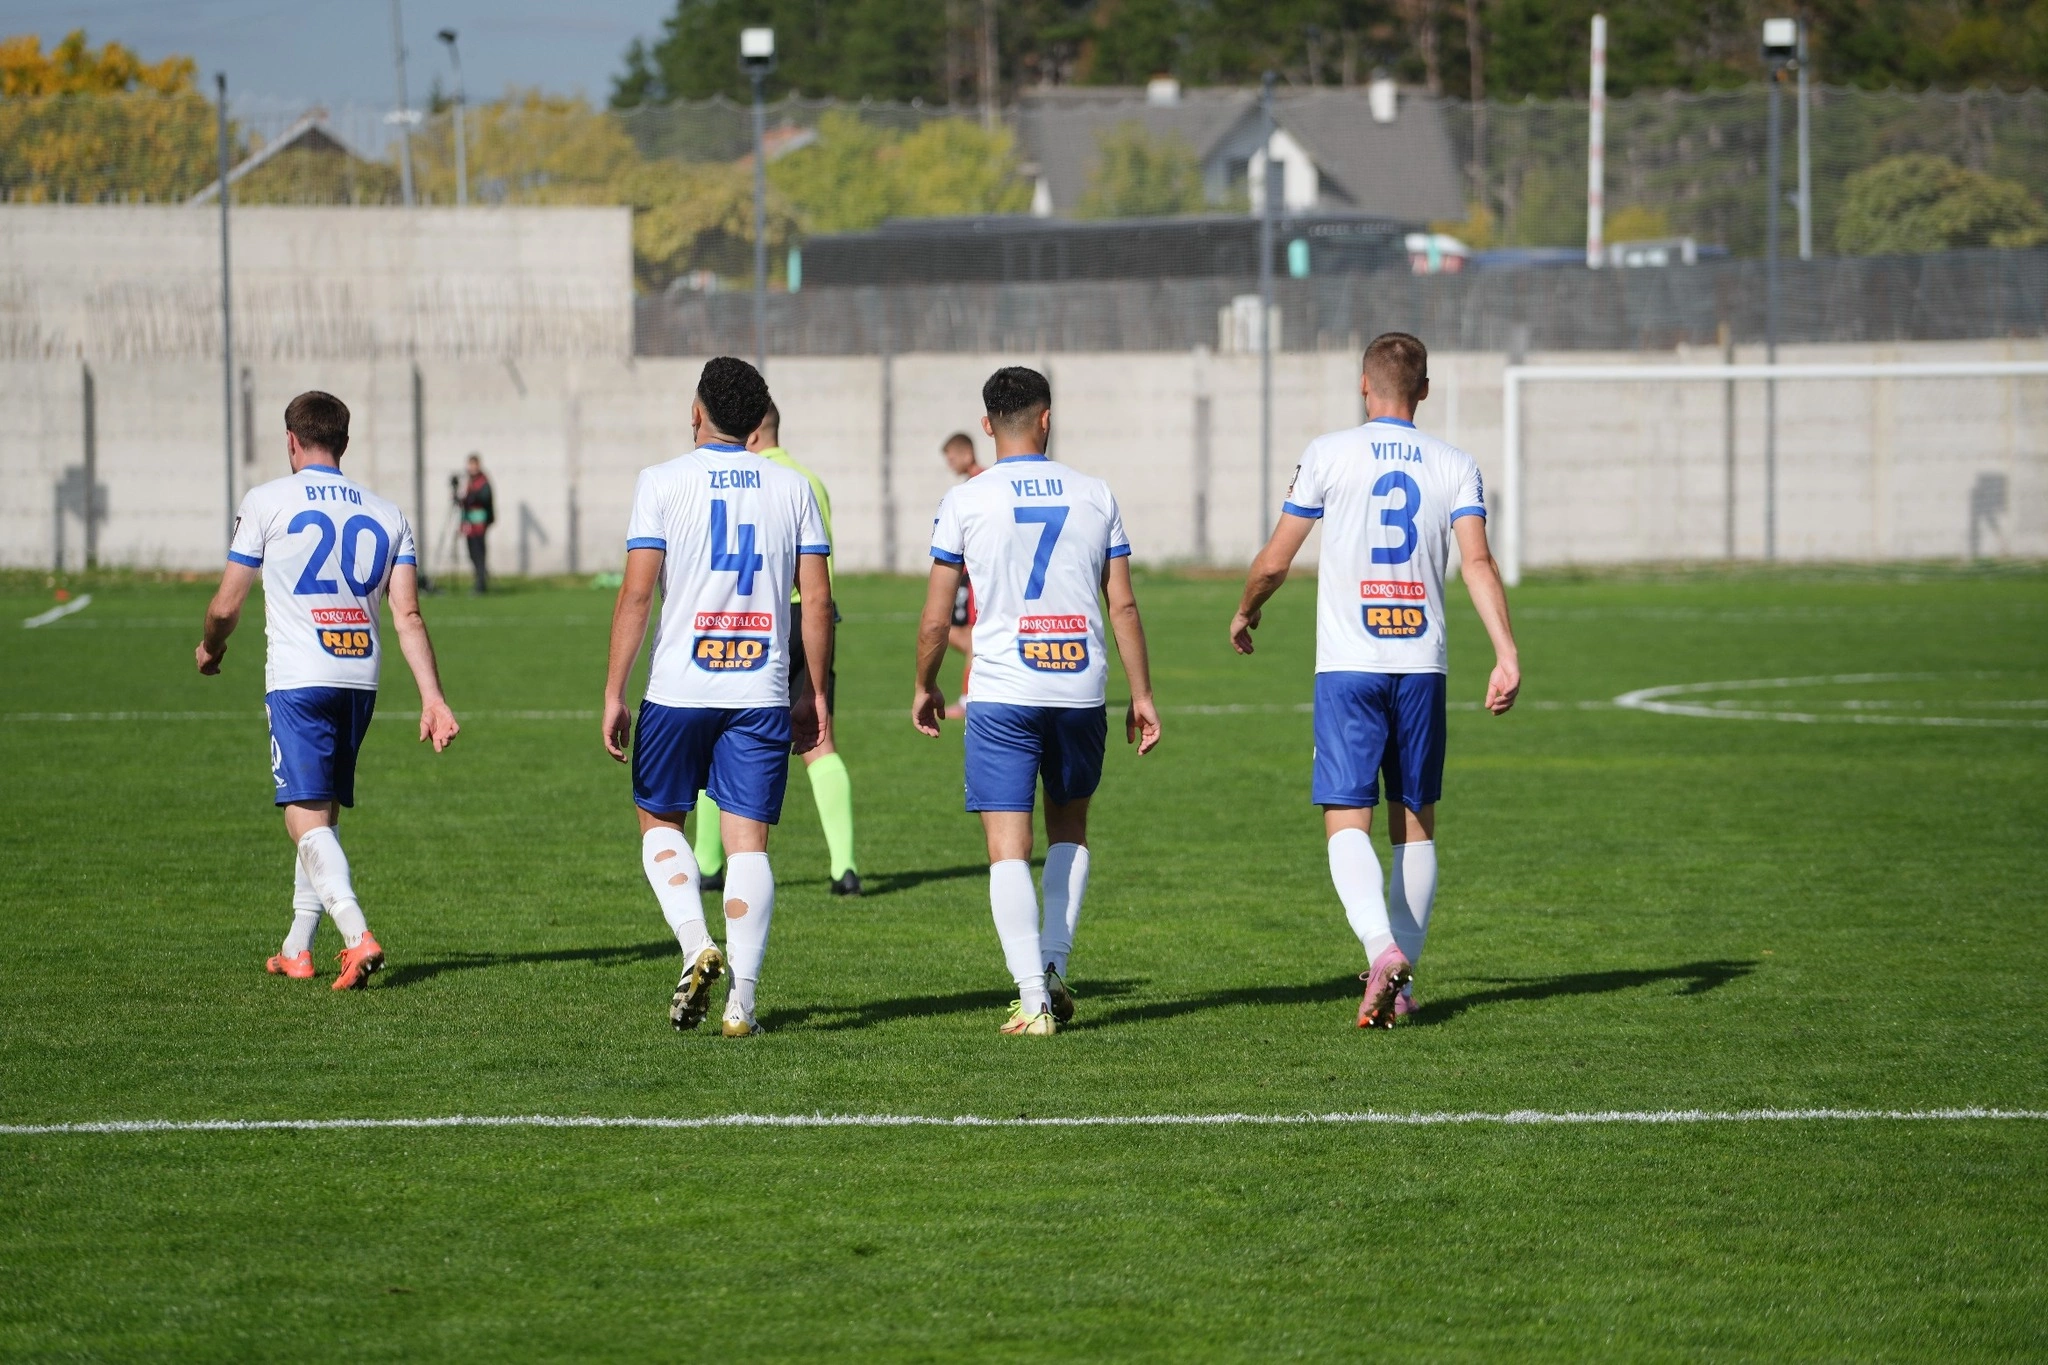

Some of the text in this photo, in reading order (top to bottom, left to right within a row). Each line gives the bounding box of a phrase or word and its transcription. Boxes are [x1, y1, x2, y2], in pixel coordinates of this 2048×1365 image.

[1370, 442, 1422, 463] VITIJA
[708, 469, 760, 489] ZEQIRI
[1010, 479, 1063, 497] VELIU
[305, 486, 362, 505] BYTYQI
[1371, 470, 1421, 564] 3
[287, 509, 390, 597] 20
[710, 499, 763, 596] 4
[1013, 505, 1070, 600] 7
[1362, 583, 1424, 598] BOROTALCO
[697, 614, 770, 629] BOROTALCO
[1020, 617, 1086, 632] BOROTALCO
[1367, 608, 1423, 626] RIO
[322, 631, 369, 648] RIO
[1378, 627, 1417, 635] mare
[697, 640, 763, 659] RIO
[1024, 642, 1085, 660] RIO
[709, 659, 752, 668] mare
[1037, 660, 1077, 670] mare
